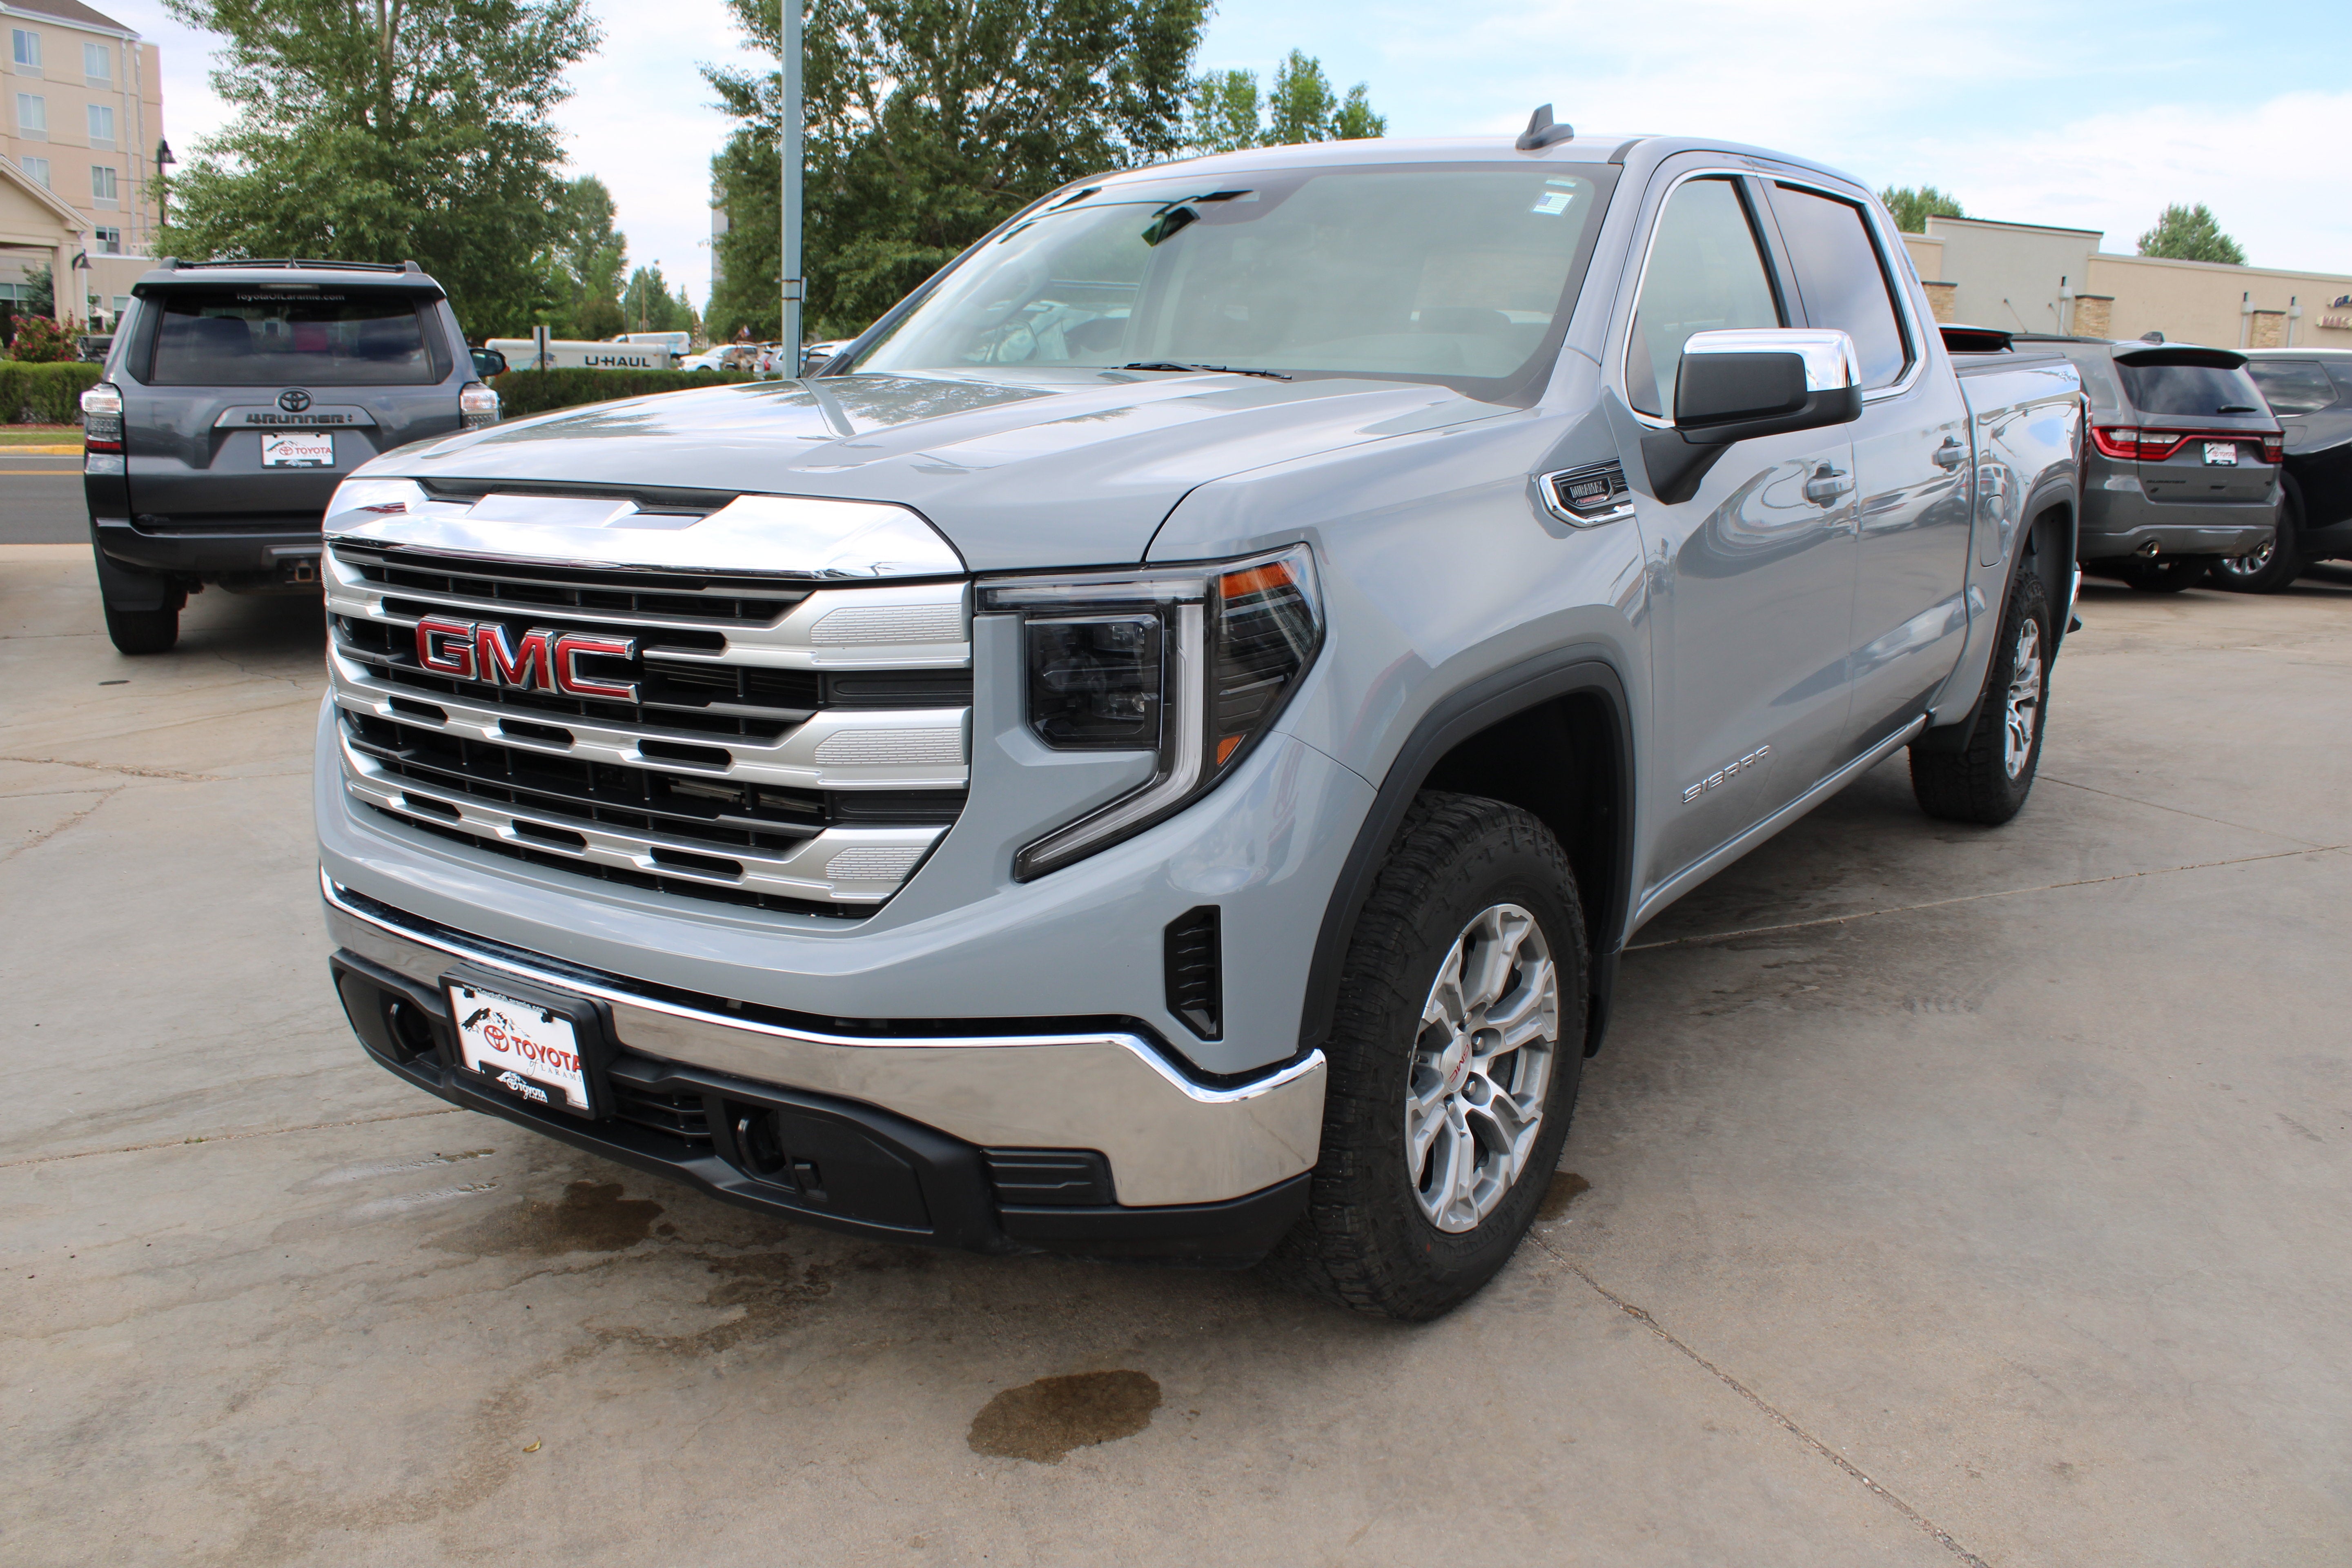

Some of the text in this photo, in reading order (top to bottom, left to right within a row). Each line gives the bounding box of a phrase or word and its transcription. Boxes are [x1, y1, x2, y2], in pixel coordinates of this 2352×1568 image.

[585, 355, 651, 367] U-HAUL
[1570, 481, 1606, 498] DURAMAX
[416, 614, 640, 704] GMC
[1681, 745, 1770, 804] SIERRA
[510, 1036, 581, 1073] TOYOTA
[1449, 1044, 1470, 1083] GMC
[527, 1058, 582, 1082] of LARAMI
[518, 1083, 547, 1099] TOYOTA
